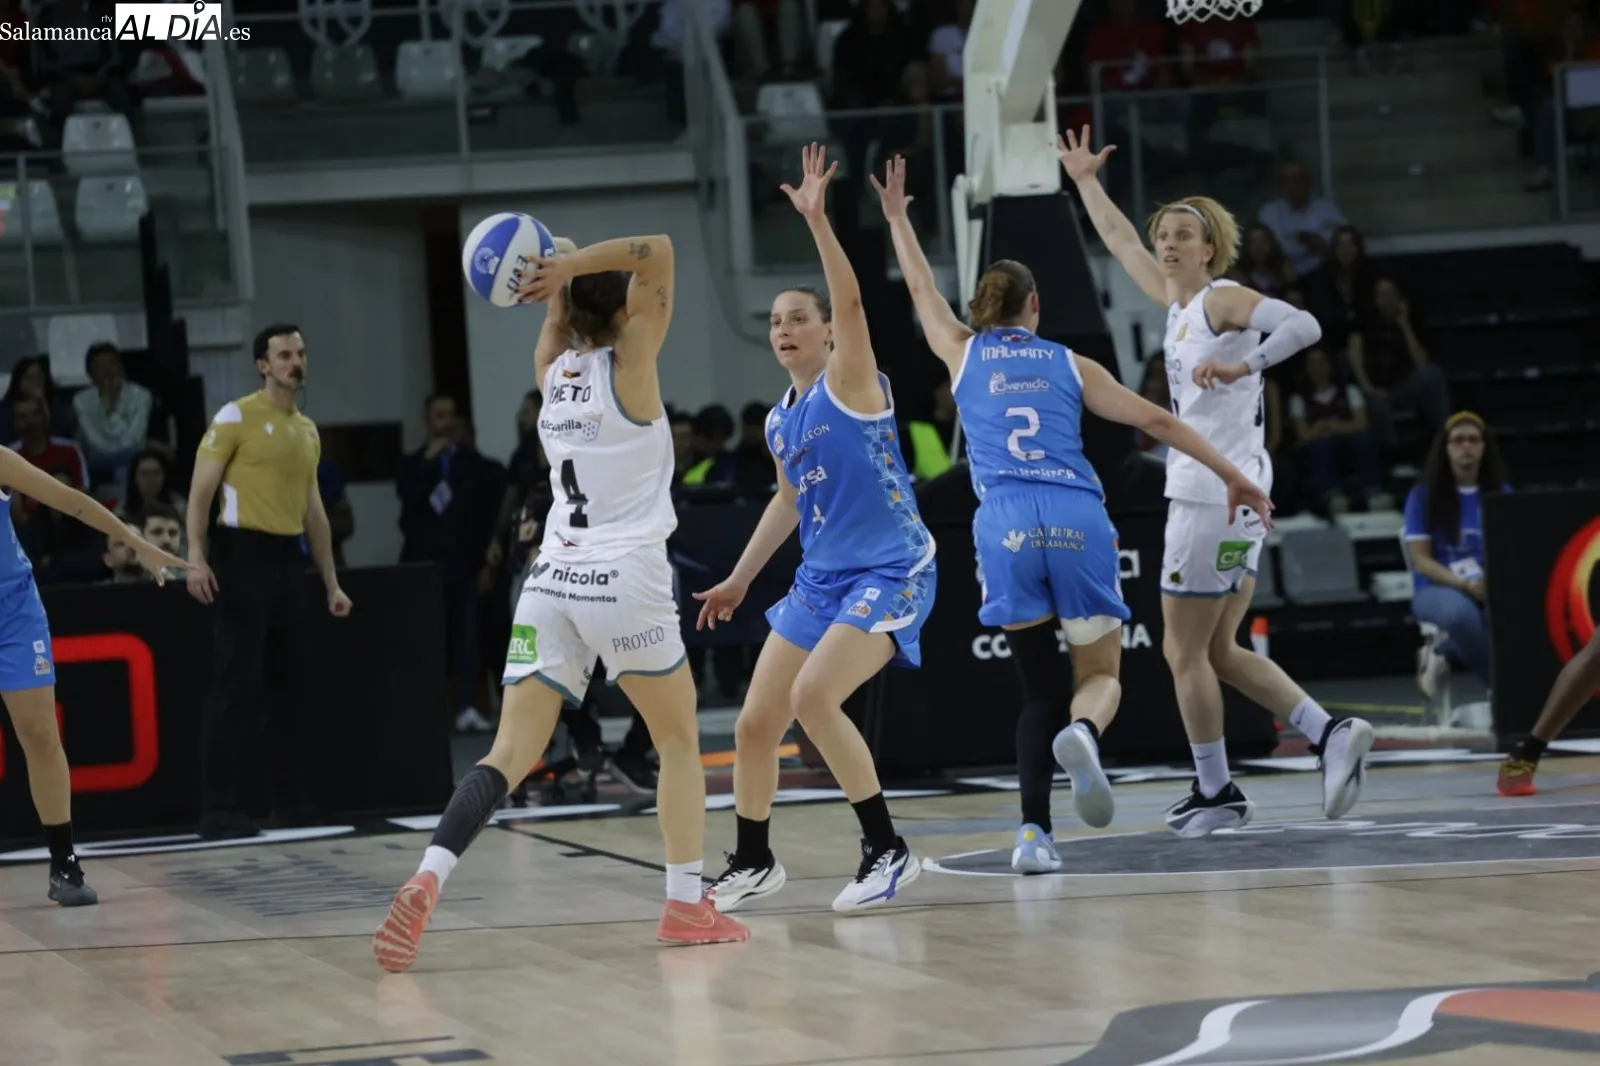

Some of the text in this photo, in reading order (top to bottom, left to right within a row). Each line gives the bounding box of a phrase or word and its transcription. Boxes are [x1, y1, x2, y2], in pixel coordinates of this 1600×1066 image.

[1005, 406, 1046, 461] 2
[561, 459, 588, 528] 4
[1051, 526, 1086, 541] RURAL
[568, 592, 618, 603] Momentos
[612, 626, 665, 653] PROYCO
